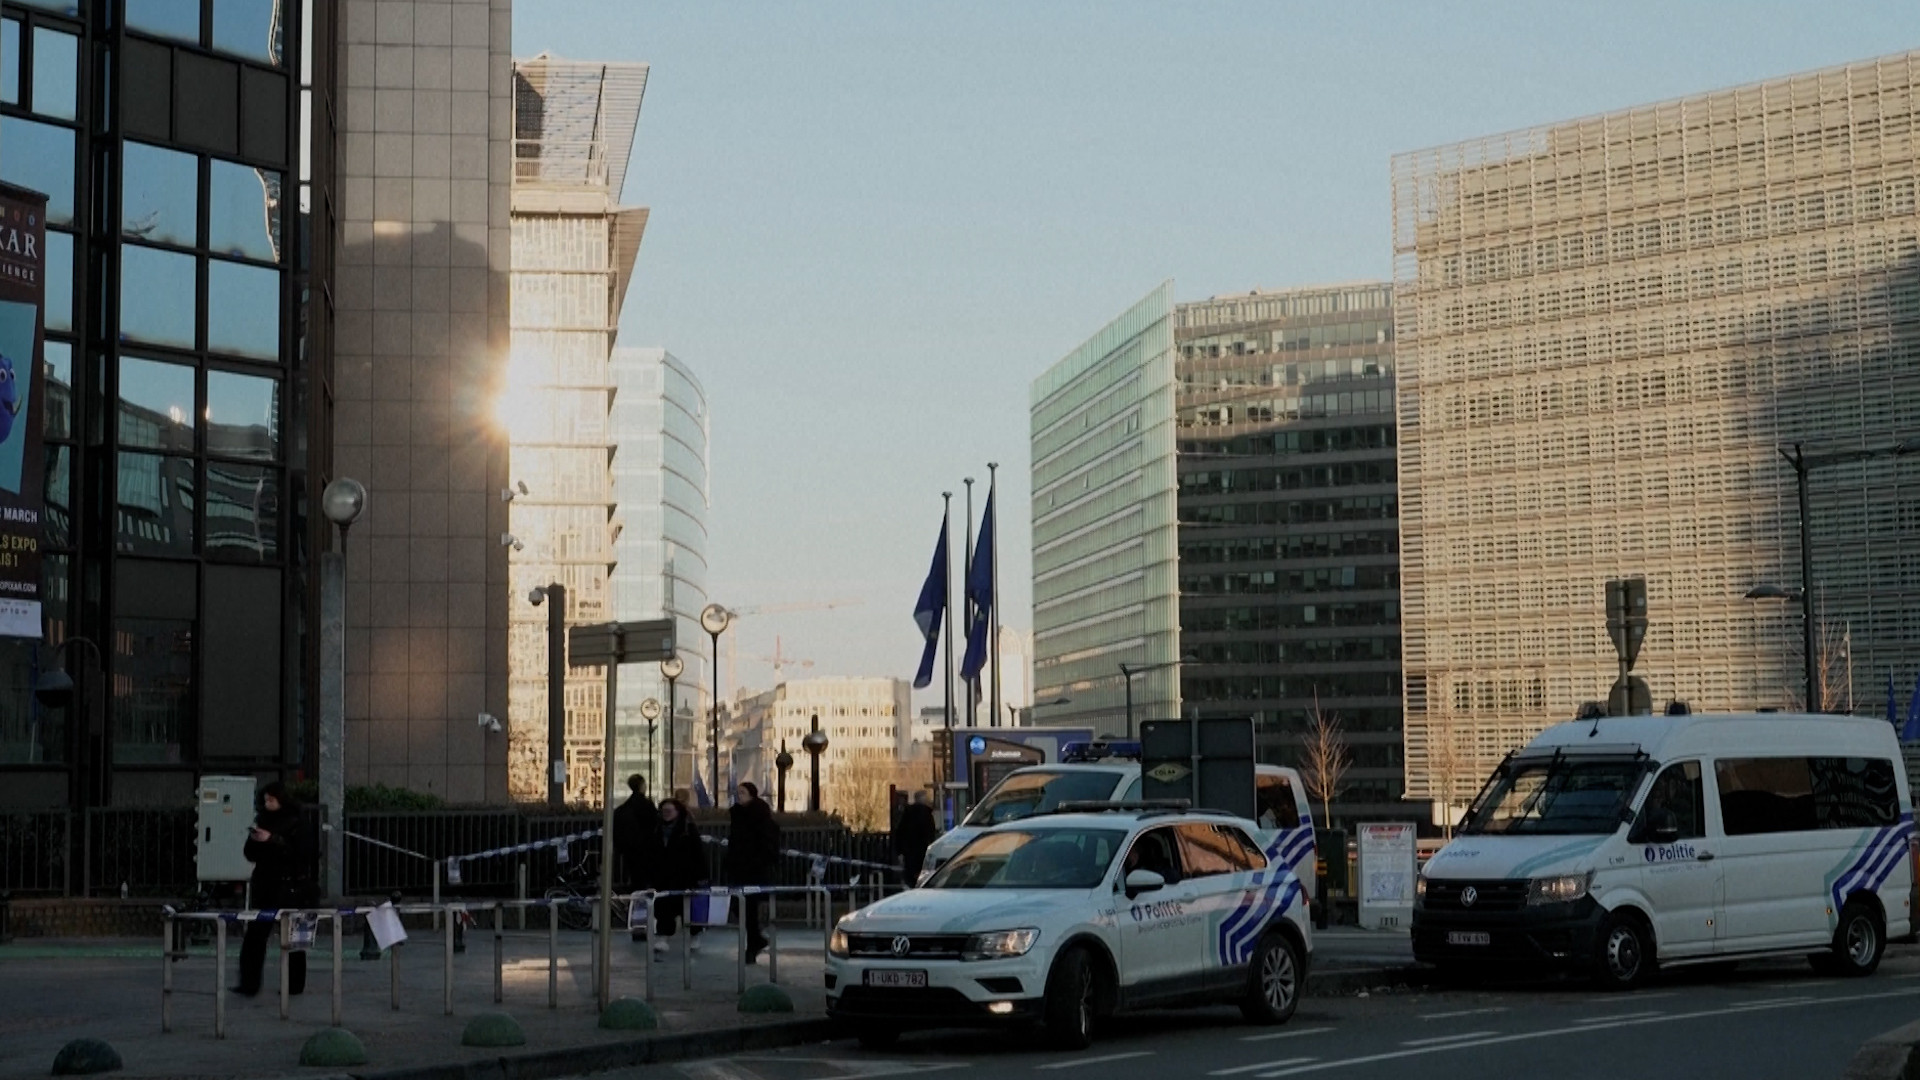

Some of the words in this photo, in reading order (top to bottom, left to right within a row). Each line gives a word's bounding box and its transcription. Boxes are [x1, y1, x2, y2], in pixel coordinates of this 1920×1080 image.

[4, 507, 38, 523] MARCH
[0, 534, 9, 549] S
[11, 537, 37, 553] EXPO
[0, 552, 11, 567] IS
[14, 554, 18, 567] 1
[1658, 843, 1696, 861] Politie
[1144, 898, 1184, 920] Politie
